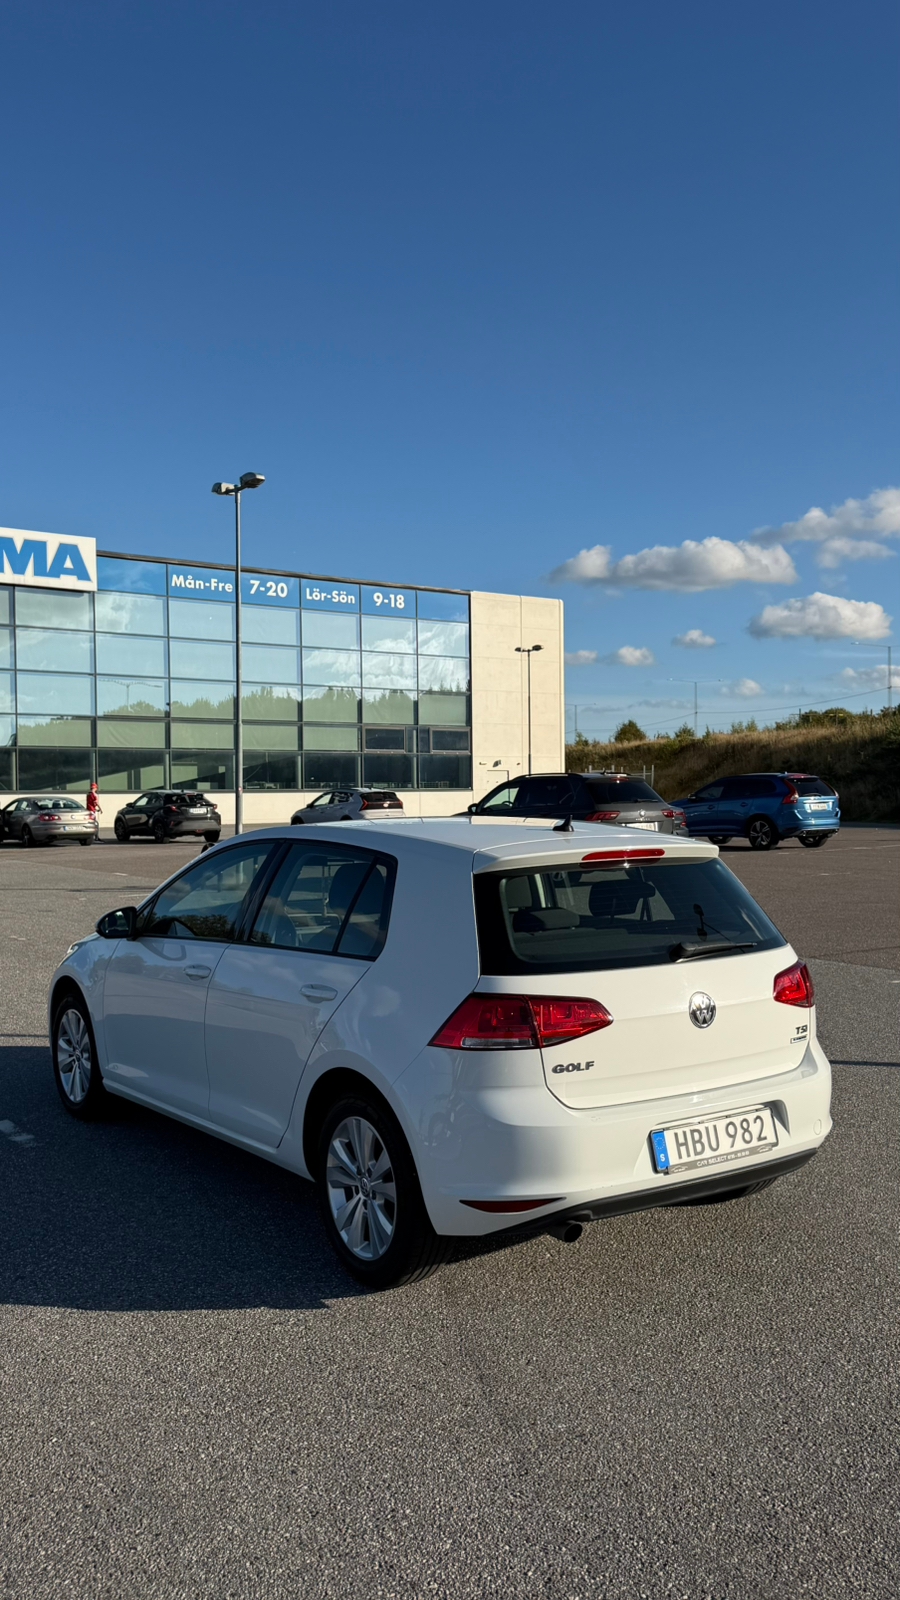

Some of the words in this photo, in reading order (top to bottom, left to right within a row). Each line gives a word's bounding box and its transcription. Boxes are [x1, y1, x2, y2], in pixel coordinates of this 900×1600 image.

[171, 574, 233, 593] Mån-Fre
[249, 580, 288, 598] 7-20
[305, 588, 355, 605] Lör-Sön
[373, 592, 405, 609] 9-18
[552, 1060, 595, 1074] GOLF
[674, 1124, 720, 1160] HBU
[725, 1115, 767, 1149] 982
[659, 1153, 666, 1162] S
